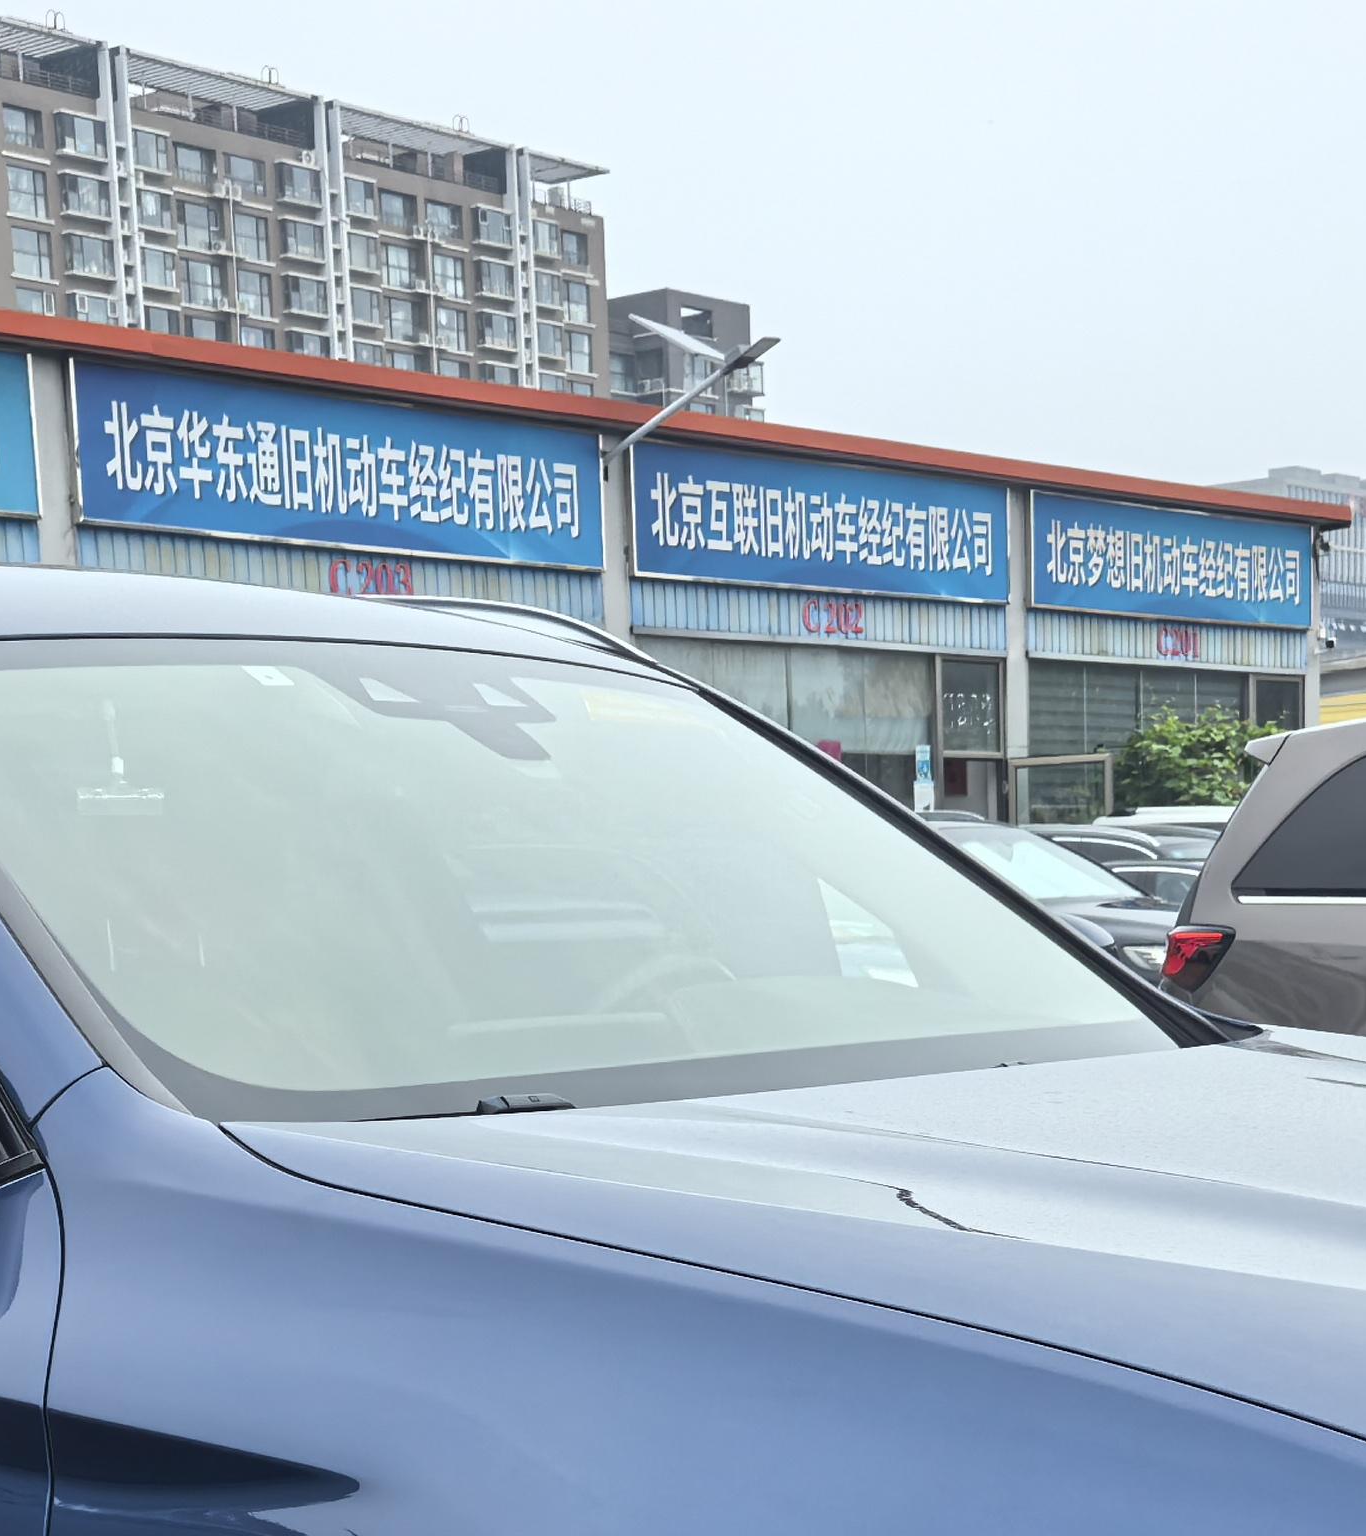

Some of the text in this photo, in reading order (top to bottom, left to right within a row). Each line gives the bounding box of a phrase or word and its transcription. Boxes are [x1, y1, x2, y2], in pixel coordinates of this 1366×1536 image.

[103, 399, 581, 540] 北京华东通旧机动车经纪有限公司
[649, 471, 994, 578] 北京互联旧机动车经纪有限公司
[1045, 517, 1302, 606] 北京梦想旧机动车经纪有限公司
[329, 559, 414, 596] C203
[802, 598, 865, 635] C202
